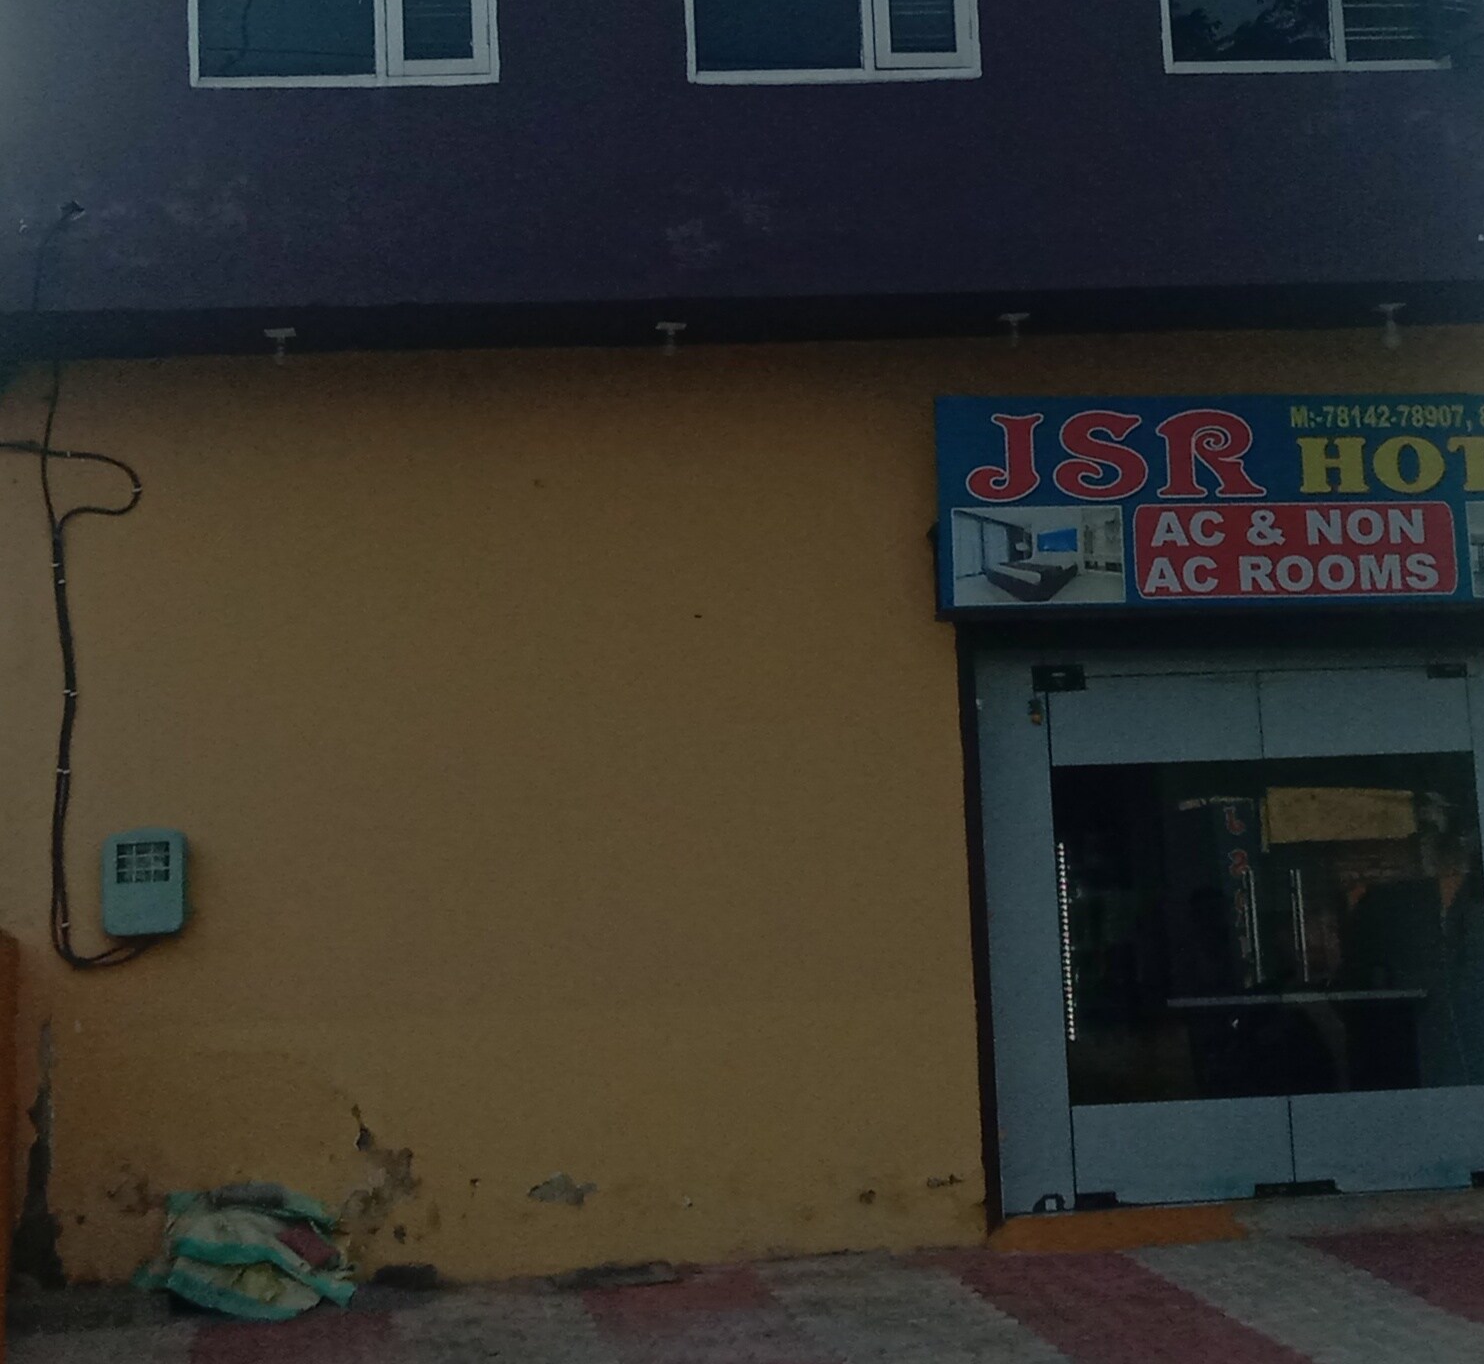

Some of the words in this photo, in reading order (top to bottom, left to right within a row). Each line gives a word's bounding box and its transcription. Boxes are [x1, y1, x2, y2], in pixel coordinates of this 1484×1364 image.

[966, 409, 1267, 501] JSR
[1151, 511, 1226, 546] AC
[1247, 509, 1285, 546] &
[1306, 508, 1426, 545] NON
[1143, 556, 1219, 593] AC
[1239, 553, 1440, 592] ROOMS
